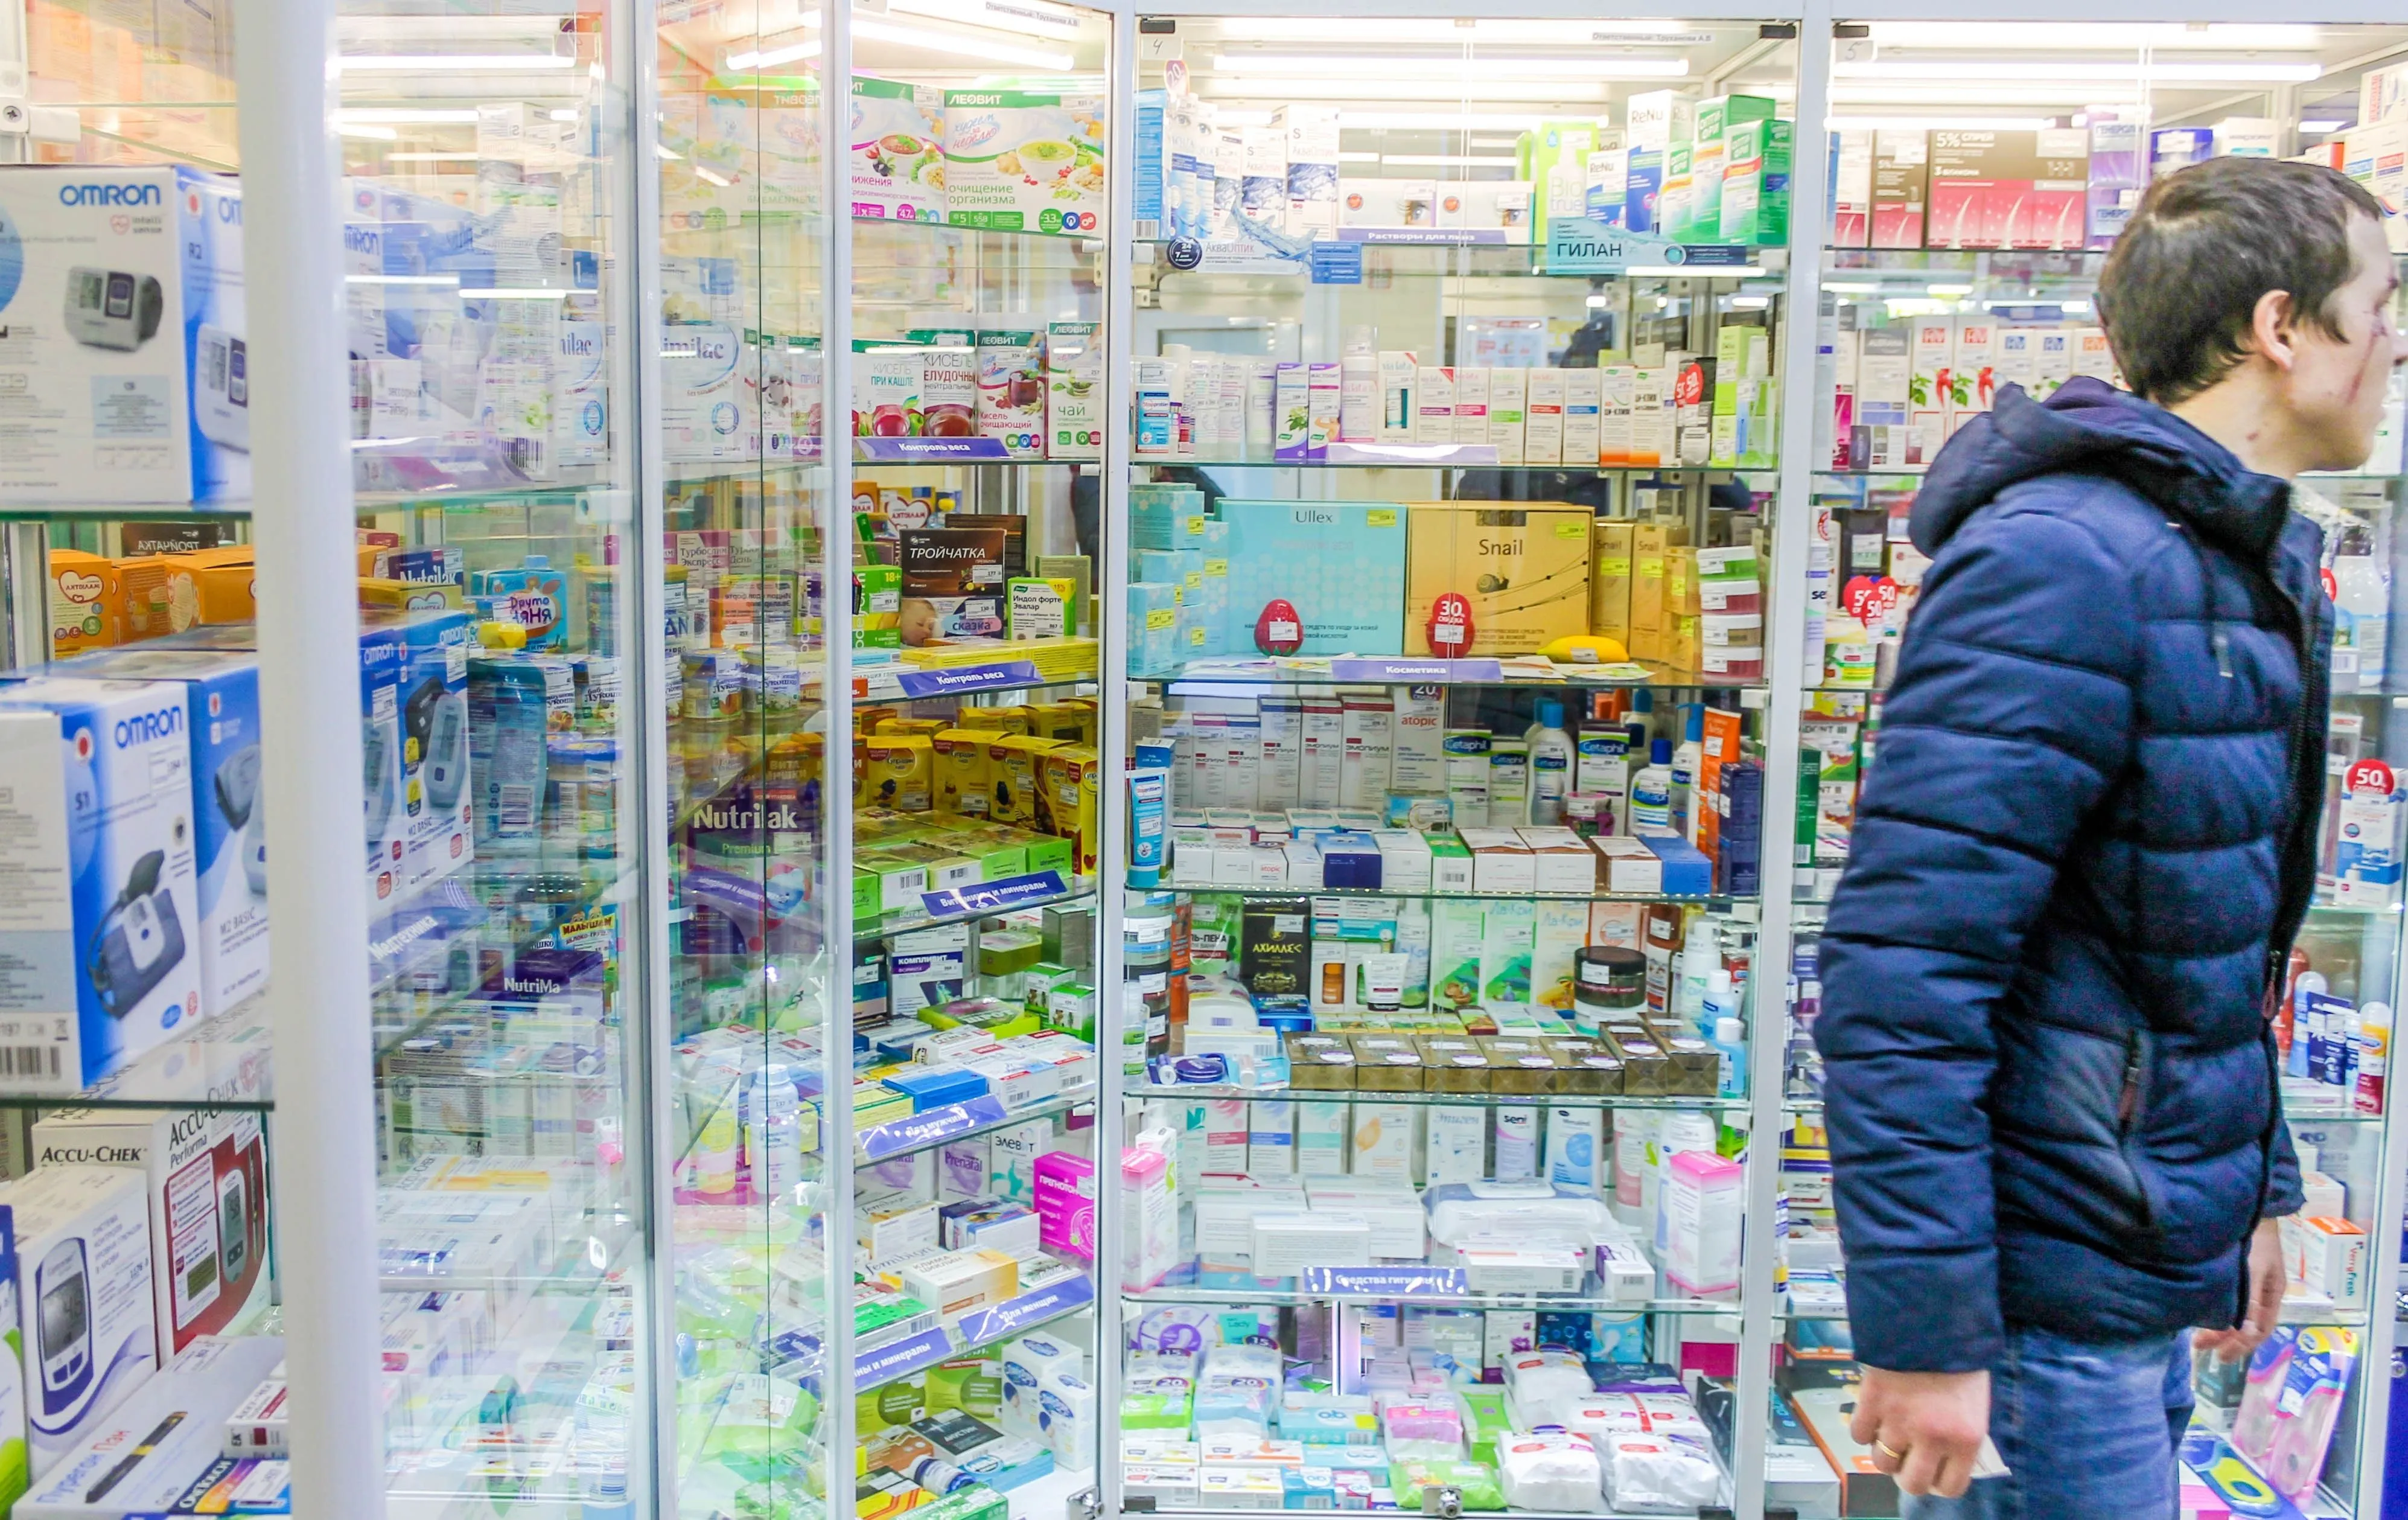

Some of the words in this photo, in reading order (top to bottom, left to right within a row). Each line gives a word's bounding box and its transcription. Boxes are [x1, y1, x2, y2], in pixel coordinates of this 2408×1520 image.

[1844, 42, 1860, 60] 5
[949, 94, 1002, 106] ЛЕОВИТ
[1631, 109, 1664, 124] ReNu
[1590, 161, 1615, 174] ReNu
[949, 185, 1013, 195] очищение
[1549, 179, 1582, 197] Bio
[59, 184, 161, 206] OMRON
[949, 195, 1016, 205] организма
[1550, 196, 1583, 211] true
[1368, 231, 1419, 241] Растворы
[1421, 232, 1442, 241] для
[1447, 232, 1475, 241] линз
[1205, 243, 1254, 254] АкваОптик
[1557, 244, 1622, 257] ГИЛАН
[1053, 326, 1093, 335] ЛЕОВИТ
[981, 336, 1016, 345] ЛЕОВИТ
[873, 363, 911, 375] КИСЕЛЬ
[870, 377, 885, 386] ПРИ
[887, 376, 914, 387] КАШЛЕ
[924, 370, 975, 383] ЕЛУДОЧНЫ
[979, 411, 1008, 421] Кисель
[1058, 403, 1086, 416] чай
[979, 421, 1032, 430] очищающий
[898, 442, 949, 453] Контроль
[951, 443, 971, 452] веса
[1295, 511, 1333, 524] Ullex
[680, 548, 728, 558] Турбослим
[910, 547, 986, 560] ТРОЙЧАТКА
[1478, 538, 1523, 556] Snail
[884, 572, 901, 583] 18+
[952, 619, 990, 631] сказка
[1386, 665, 1447, 674] Косметика
[936, 672, 982, 686] Контроль
[984, 671, 1005, 681] веса
[115, 705, 183, 750] OMRON
[1401, 717, 1437, 727] atopic
[1445, 737, 1487, 753] Cetaphil
[1581, 739, 1627, 755] Cetaphil
[1491, 755, 1526, 767] Cetaphil
[2355, 768, 2383, 785] 50
[693, 803, 798, 830] Nutrilak
[722, 843, 771, 855] Premium
[999, 880, 1048, 895] минералы
[368, 915, 439, 960] Медтехника
[1252, 944, 1302, 954] АХИЛЛЕС
[898, 955, 948, 965] КОМПЛИВИТ
[504, 977, 561, 994] NutriMa
[1503, 1114, 1527, 1125] seni
[995, 1135, 1034, 1153] Элевт
[40, 1146, 141, 1162] ACCU-CHEK
[170, 1134, 208, 1170] Performa
[944, 1151, 983, 1172] Prenatal
[1000, 1305, 1022, 1323] Для
[1022, 1294, 1059, 1314] женщин
[881, 1344, 932, 1365] минералы
